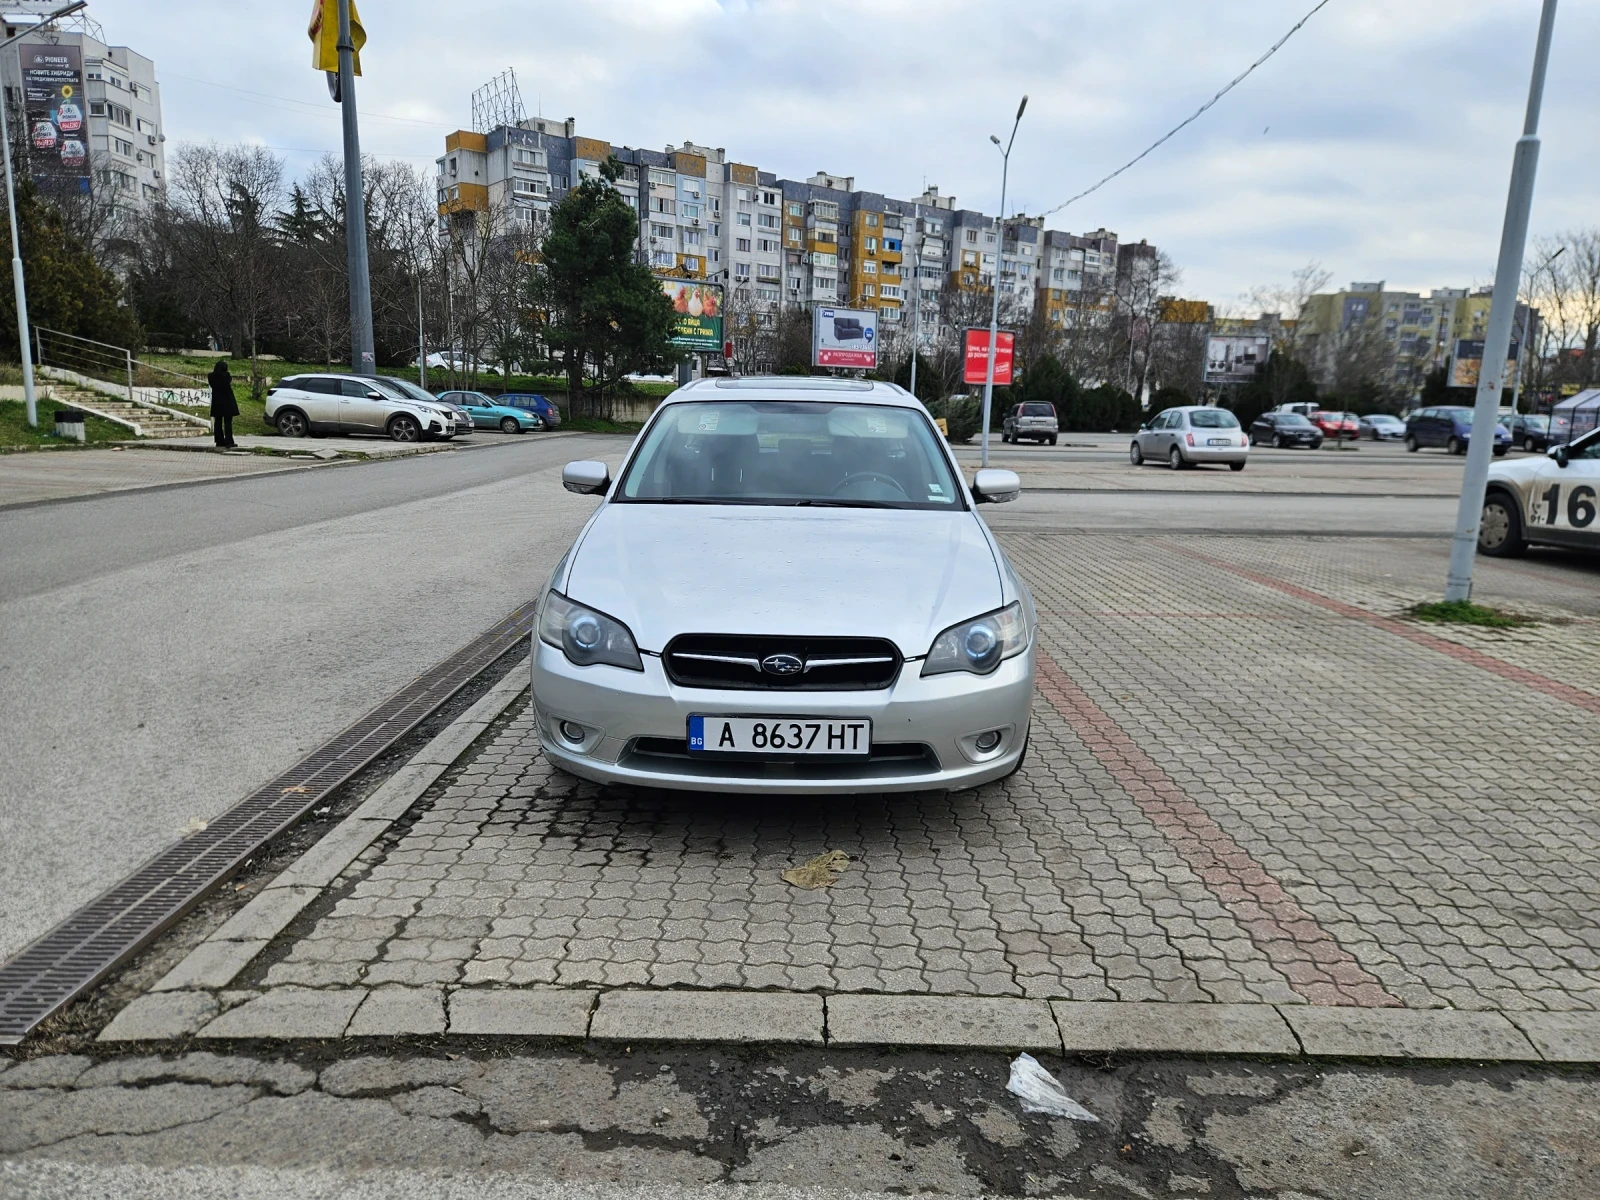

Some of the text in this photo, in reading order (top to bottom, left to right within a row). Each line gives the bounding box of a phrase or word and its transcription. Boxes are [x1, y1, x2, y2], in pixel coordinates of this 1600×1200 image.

[30, 69, 50, 77] НОВИТЕ
[832, 351, 863, 359] РАЗПРОДАЖБА
[1542, 484, 1596, 528] 16
[719, 722, 864, 750] A 8637 HT
[690, 737, 703, 746] BG
